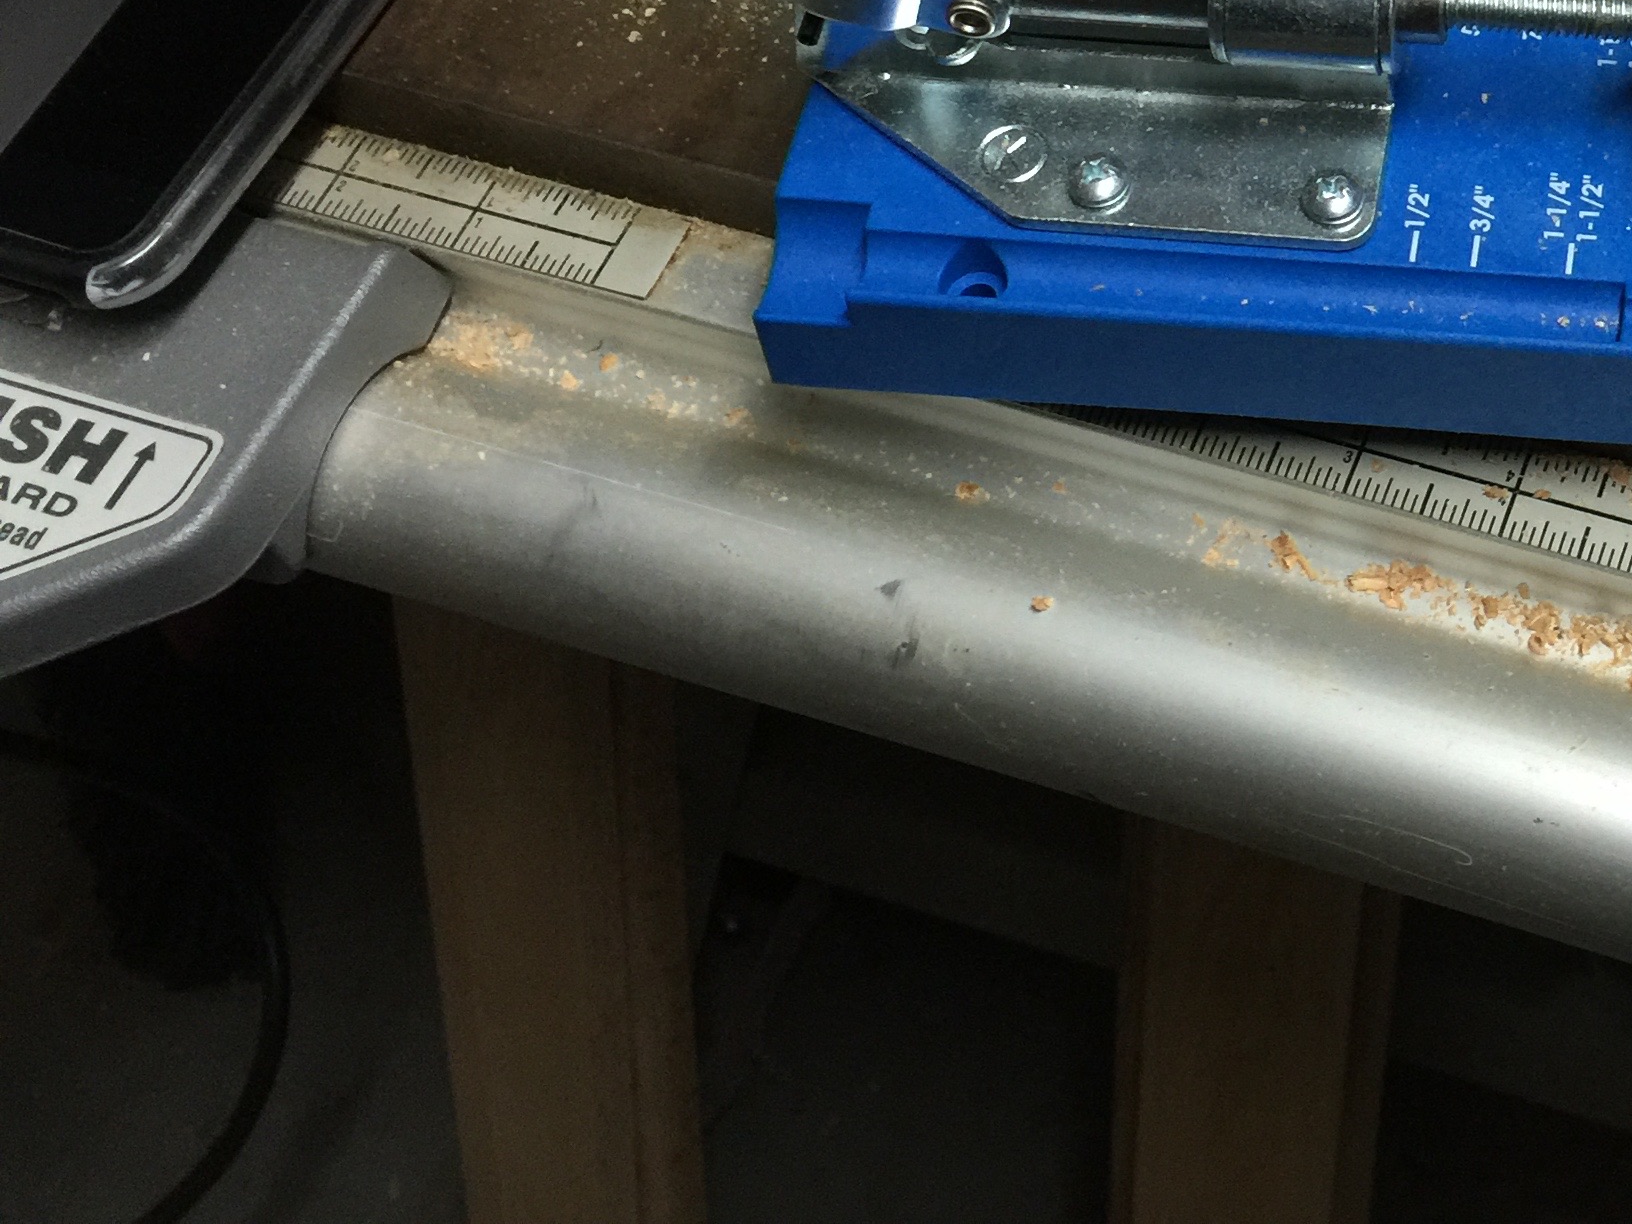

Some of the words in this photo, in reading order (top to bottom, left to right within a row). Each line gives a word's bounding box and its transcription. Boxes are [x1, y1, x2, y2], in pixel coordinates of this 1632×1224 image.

[335, 179, 347, 192] 2
[1404, 182, 1431, 230] 1/2"
[1469, 185, 1495, 232] 3/4"
[1543, 172, 1571, 239] 1-1/4"
[1576, 174, 1604, 243] 1-1/2"
[1342, 450, 1354, 464] 3
